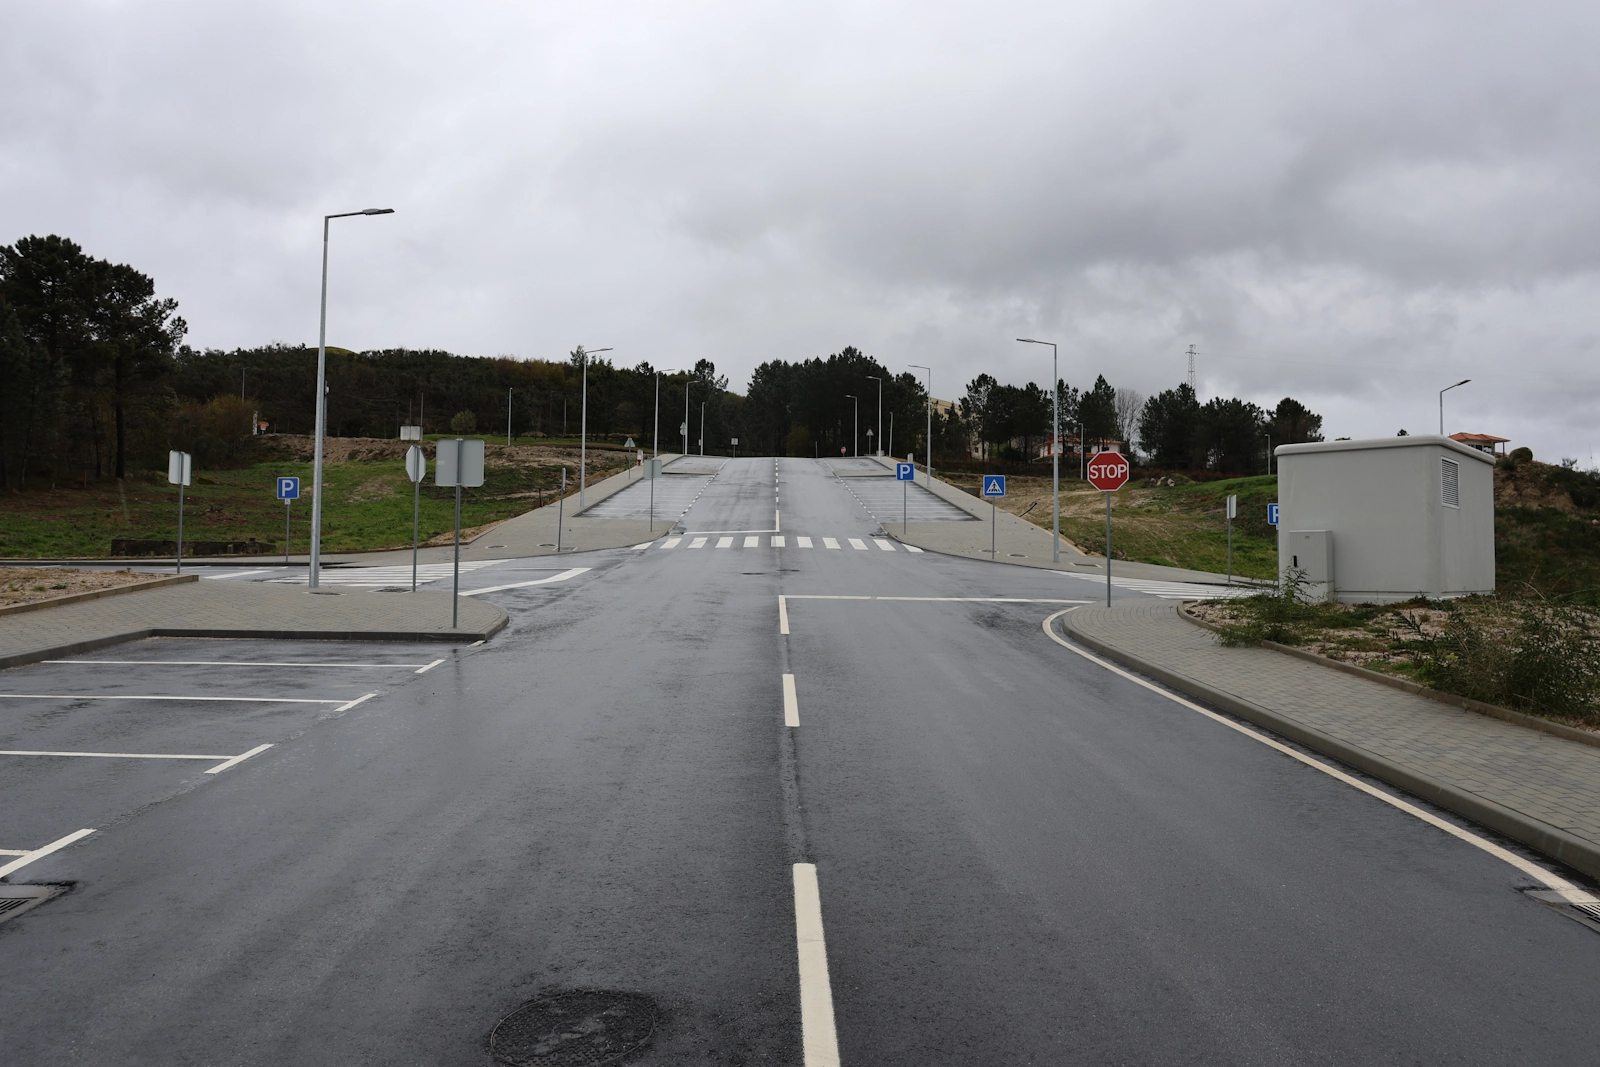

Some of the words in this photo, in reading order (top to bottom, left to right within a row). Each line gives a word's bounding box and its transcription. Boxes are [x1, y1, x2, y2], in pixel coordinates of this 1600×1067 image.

[900, 464, 911, 479] P
[1090, 464, 1127, 479] STOP
[282, 480, 294, 496] P
